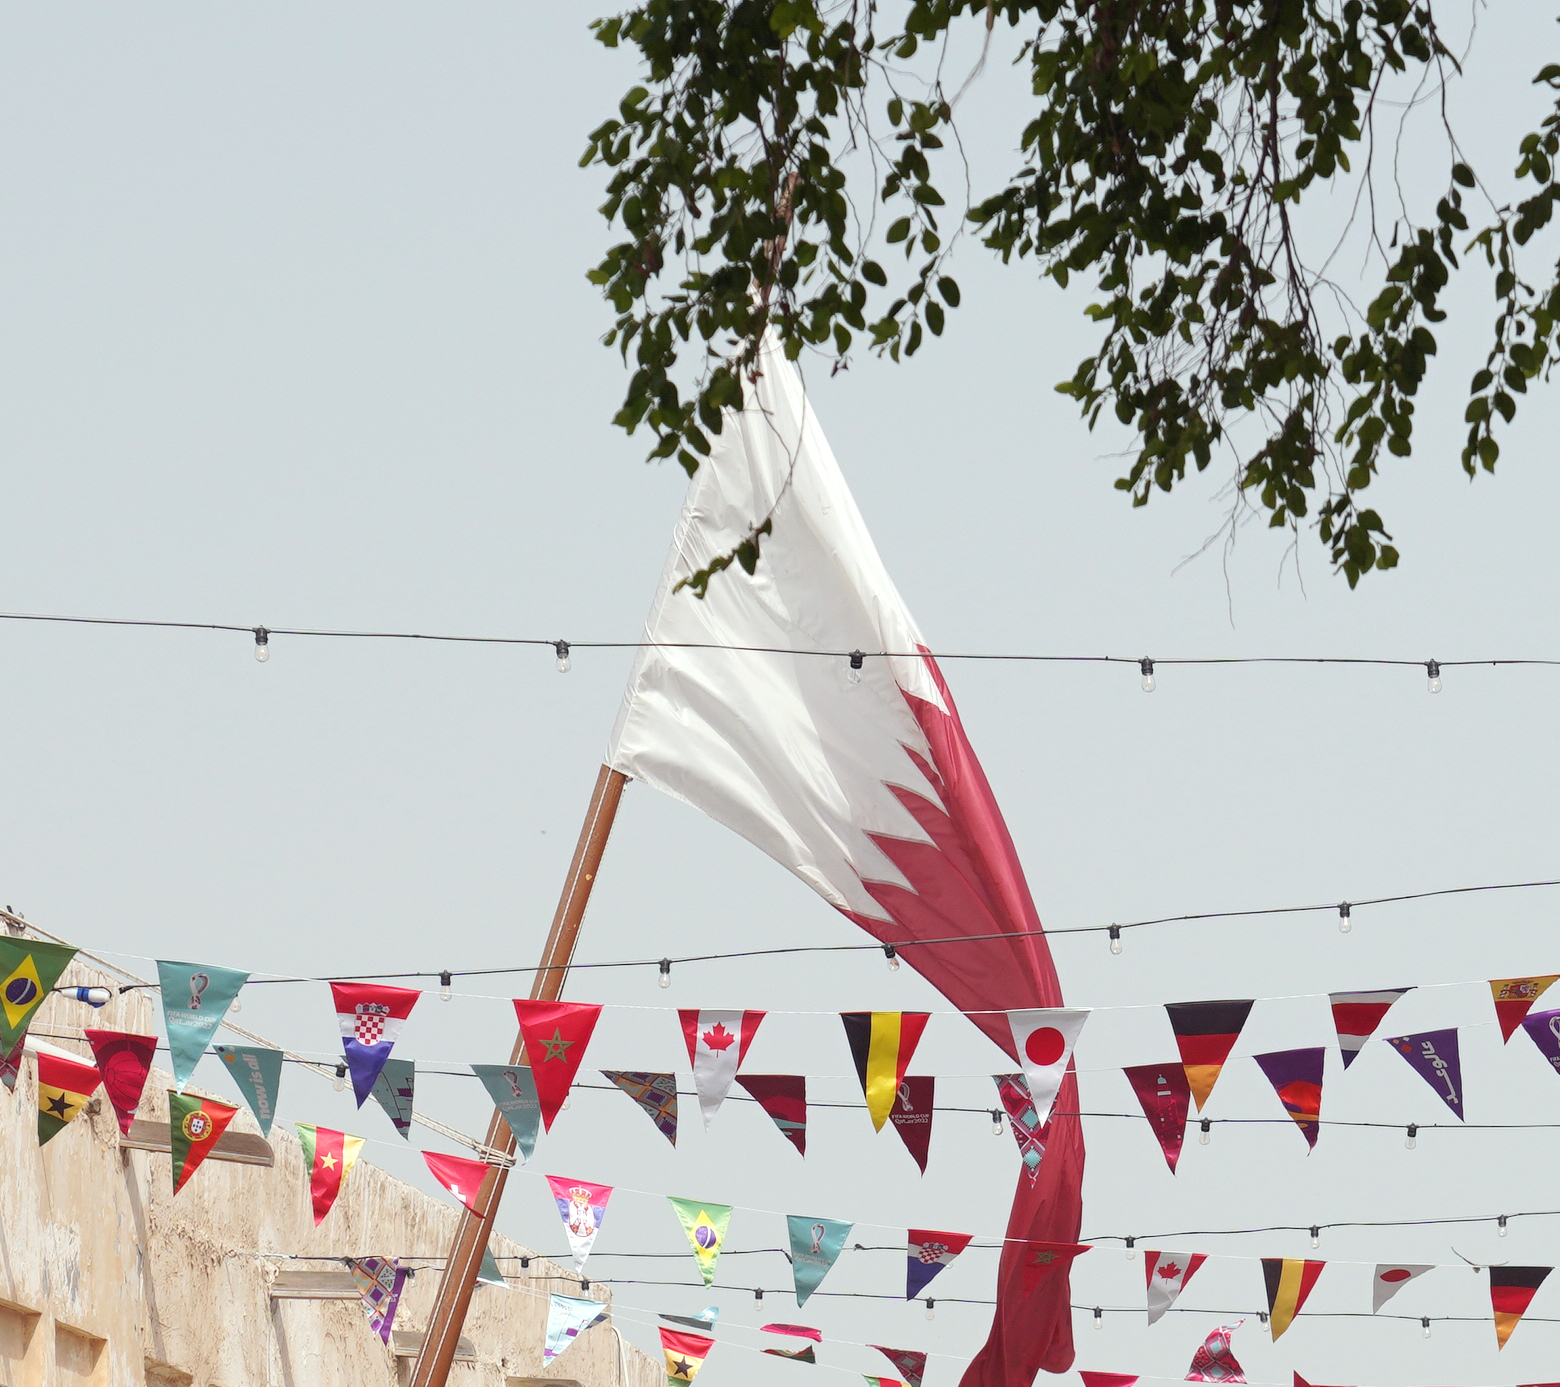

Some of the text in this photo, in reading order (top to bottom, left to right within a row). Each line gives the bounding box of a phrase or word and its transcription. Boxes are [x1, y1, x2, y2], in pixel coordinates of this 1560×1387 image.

[167, 1010, 216, 1023] FIFA WORLD CUP
